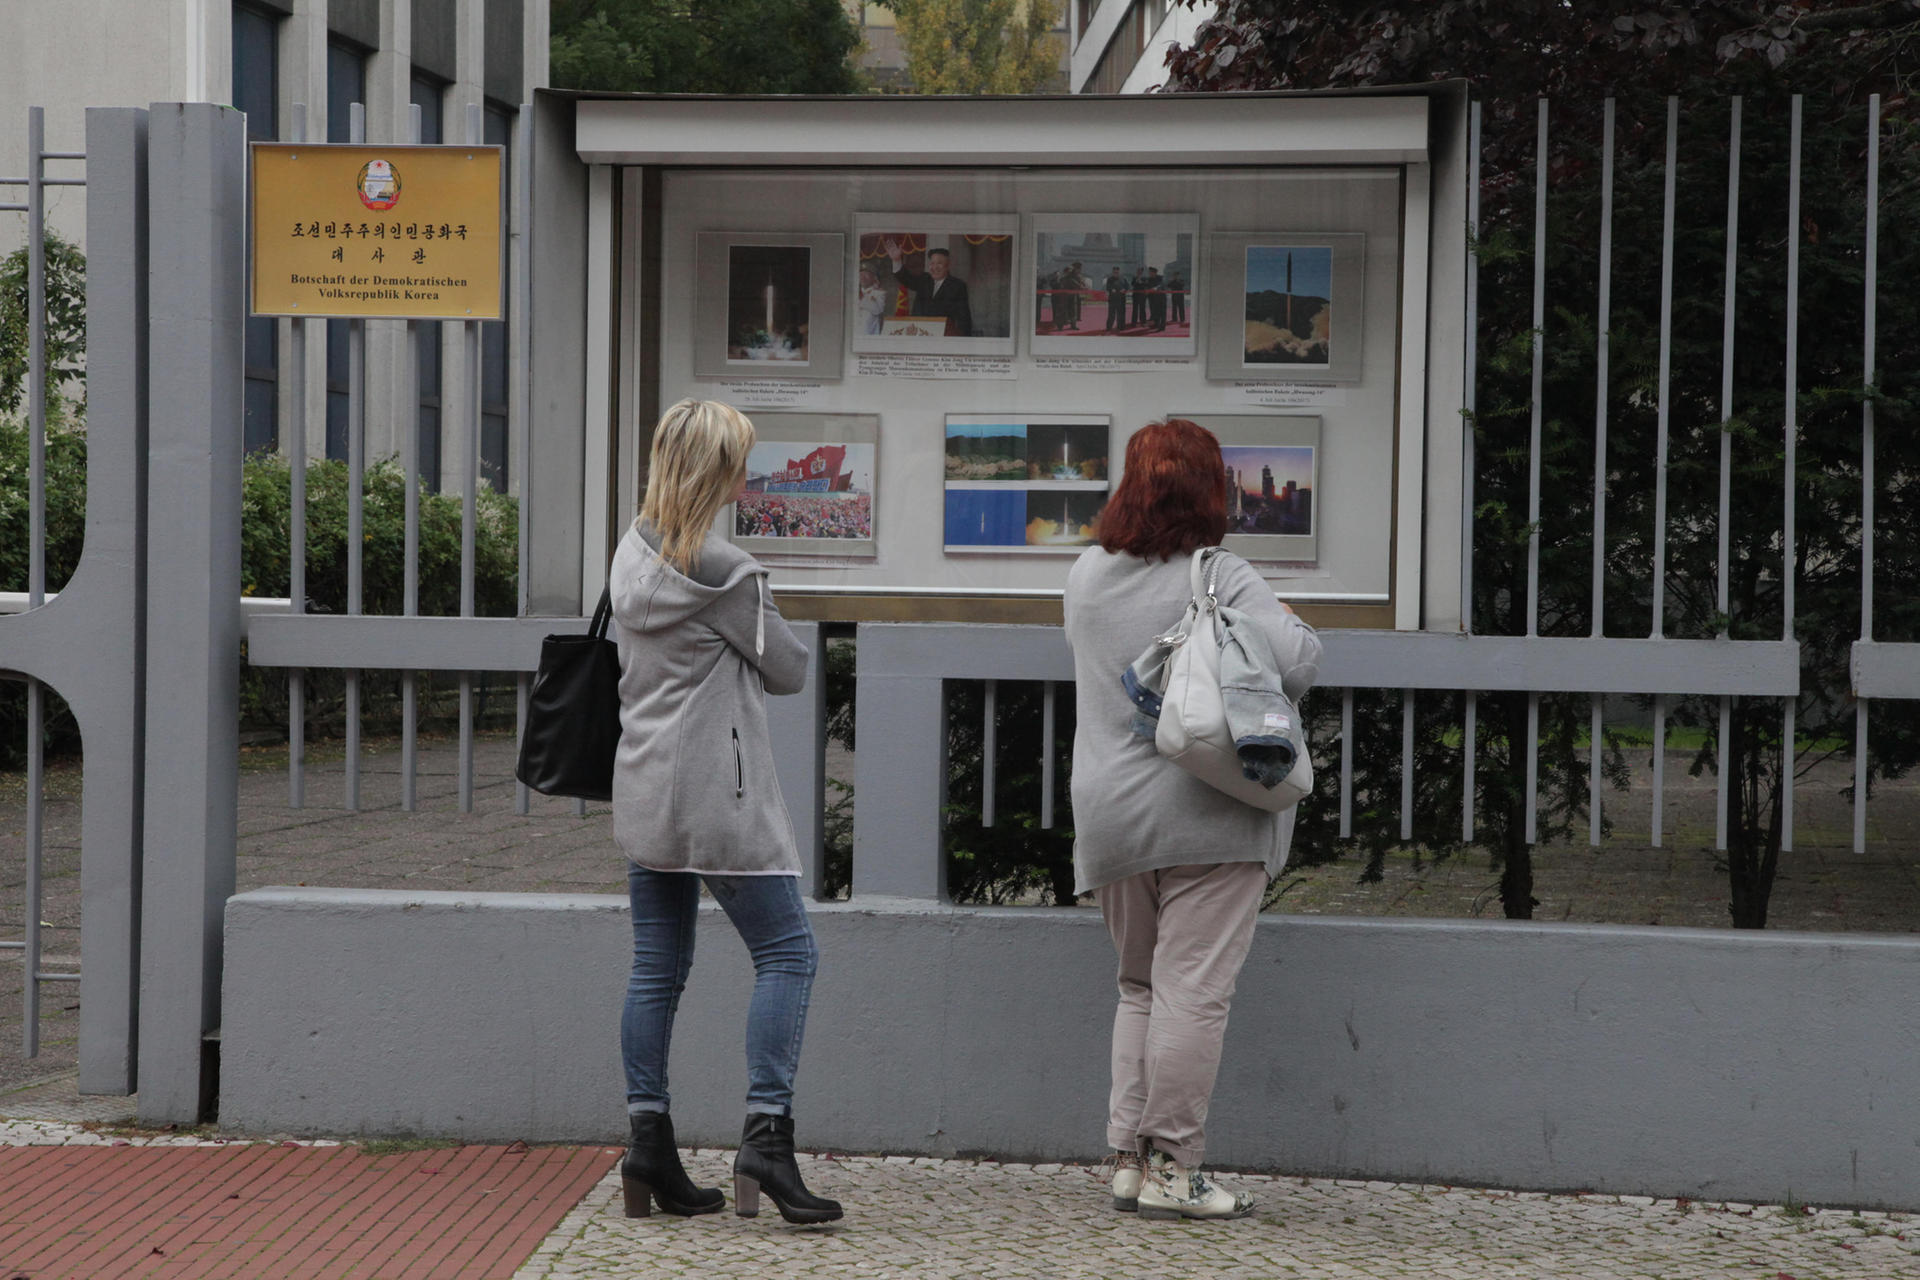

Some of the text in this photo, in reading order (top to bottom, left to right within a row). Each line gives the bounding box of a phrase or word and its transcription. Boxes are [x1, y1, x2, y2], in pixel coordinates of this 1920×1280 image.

[291, 220, 468, 241] 조선민주주의인민공화국
[291, 273, 467, 287] Botschaft der Demokratischen
[318, 288, 439, 301] Volksrepublik Korea
